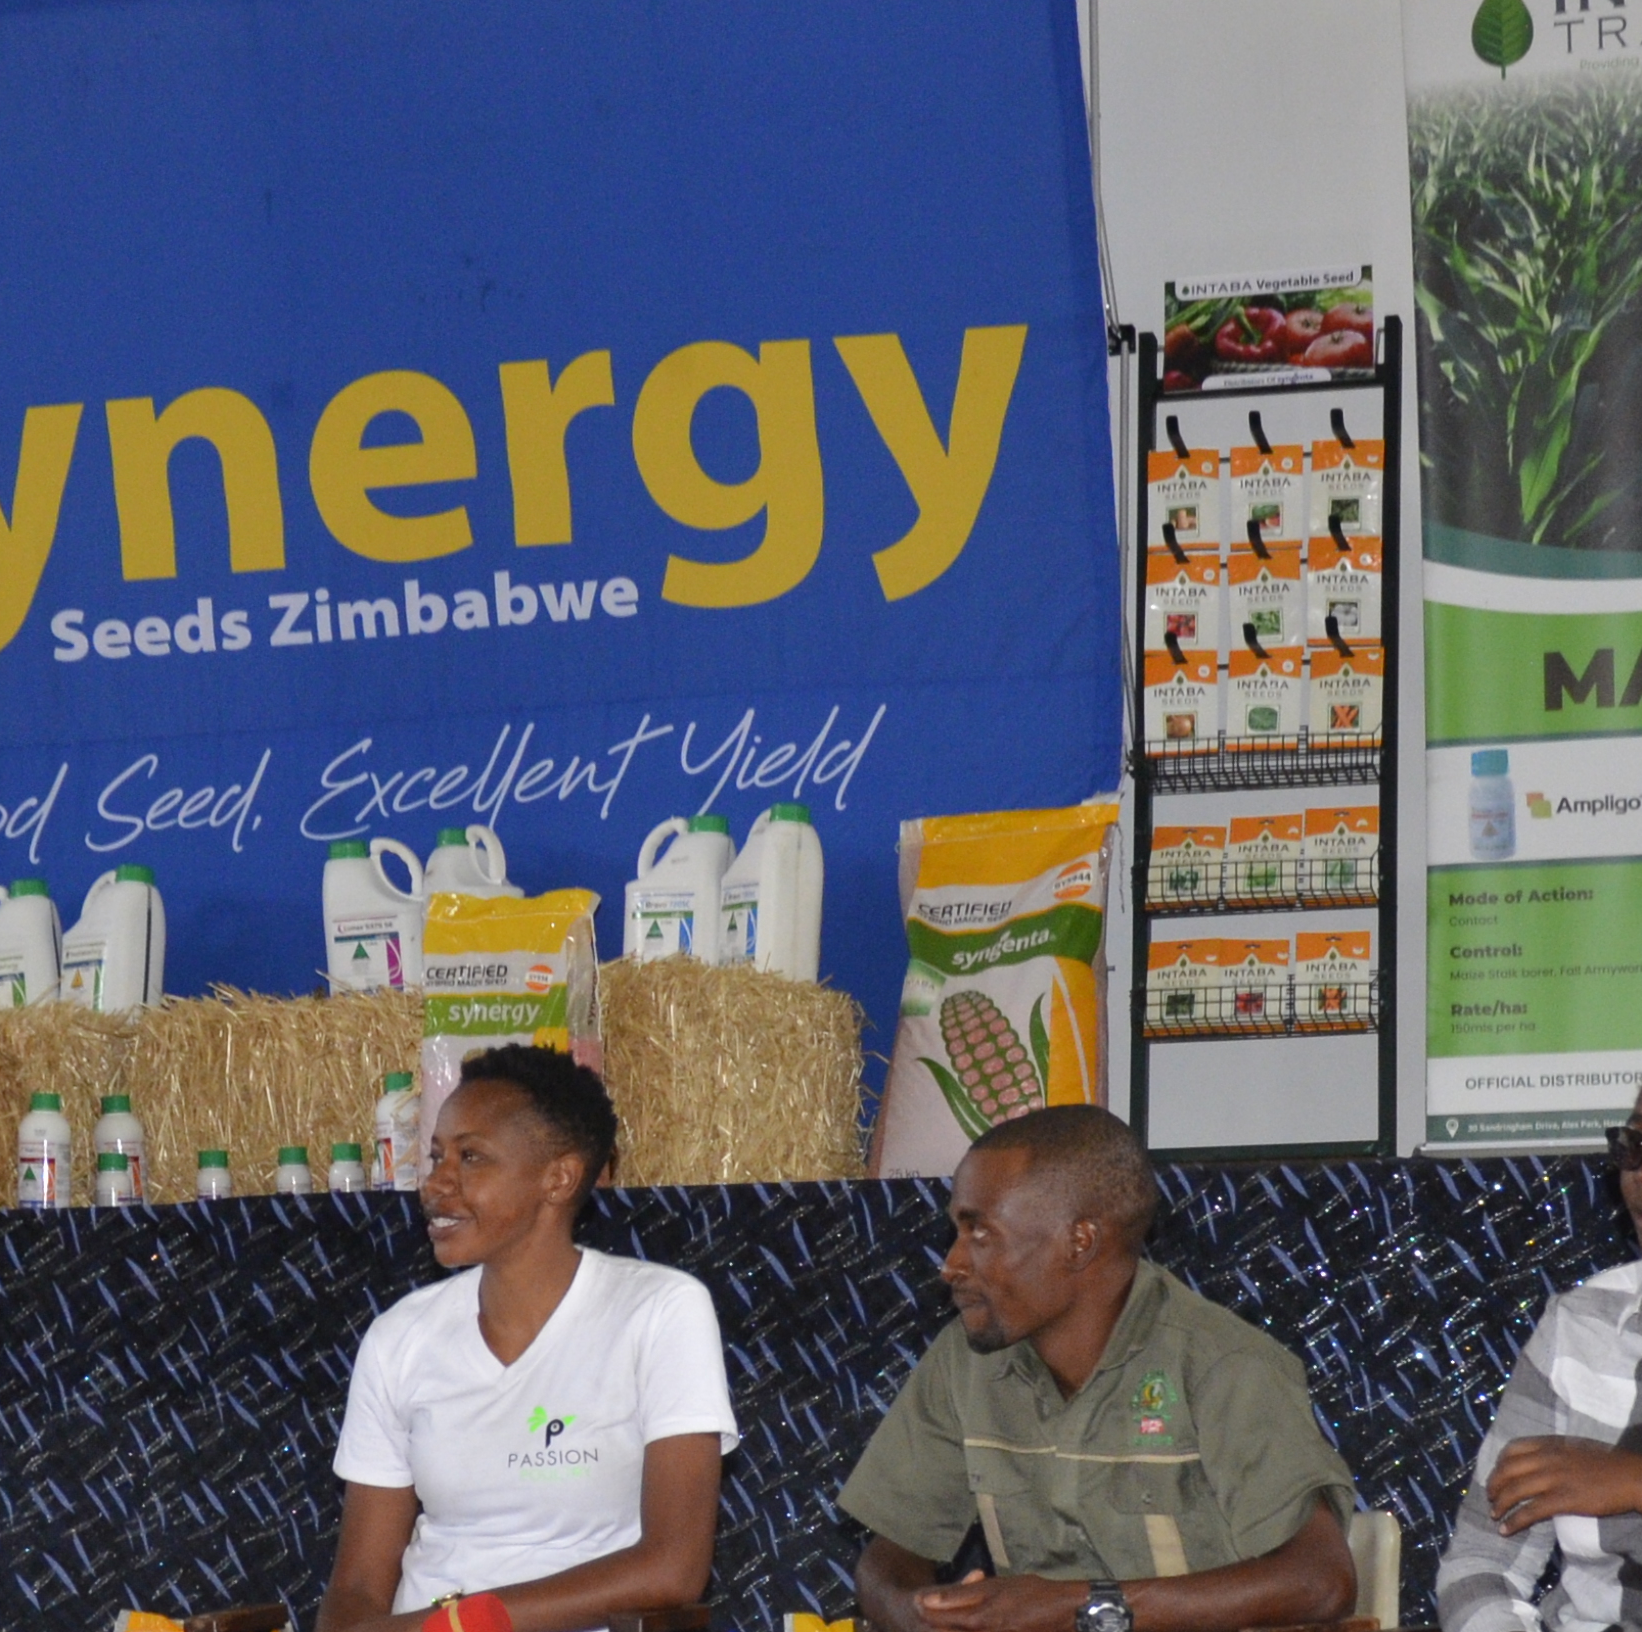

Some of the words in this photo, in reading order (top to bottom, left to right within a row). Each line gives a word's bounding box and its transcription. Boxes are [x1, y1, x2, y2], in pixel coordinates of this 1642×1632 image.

[1191, 280, 1252, 295] INTABA
[1257, 275, 1320, 291] Vegetable
[1323, 271, 1354, 284] Seed
[51, 599, 253, 665] Seeds
[268, 570, 639, 648] Zimbabwe
[300, 715, 673, 843] Excellent
[679, 704, 888, 816] Yield
[1557, 794, 1642, 815] Ampligo
[1449, 892, 1498, 906] Mode
[1504, 889, 1522, 904] of
[1528, 887, 1594, 903] Action:
[918, 901, 1012, 918] CERTIFIED
[1449, 916, 1498, 927] Contact
[952, 928, 1050, 970] syngenta
[1450, 943, 1522, 959] Control:
[426, 964, 507, 980] CERTIFIED
[449, 1001, 540, 1026] synergy
[1451, 1000, 1527, 1017] Rate/ha:
[1465, 1076, 1535, 1090] OFFICIAL
[508, 1448, 599, 1468] PASSION
